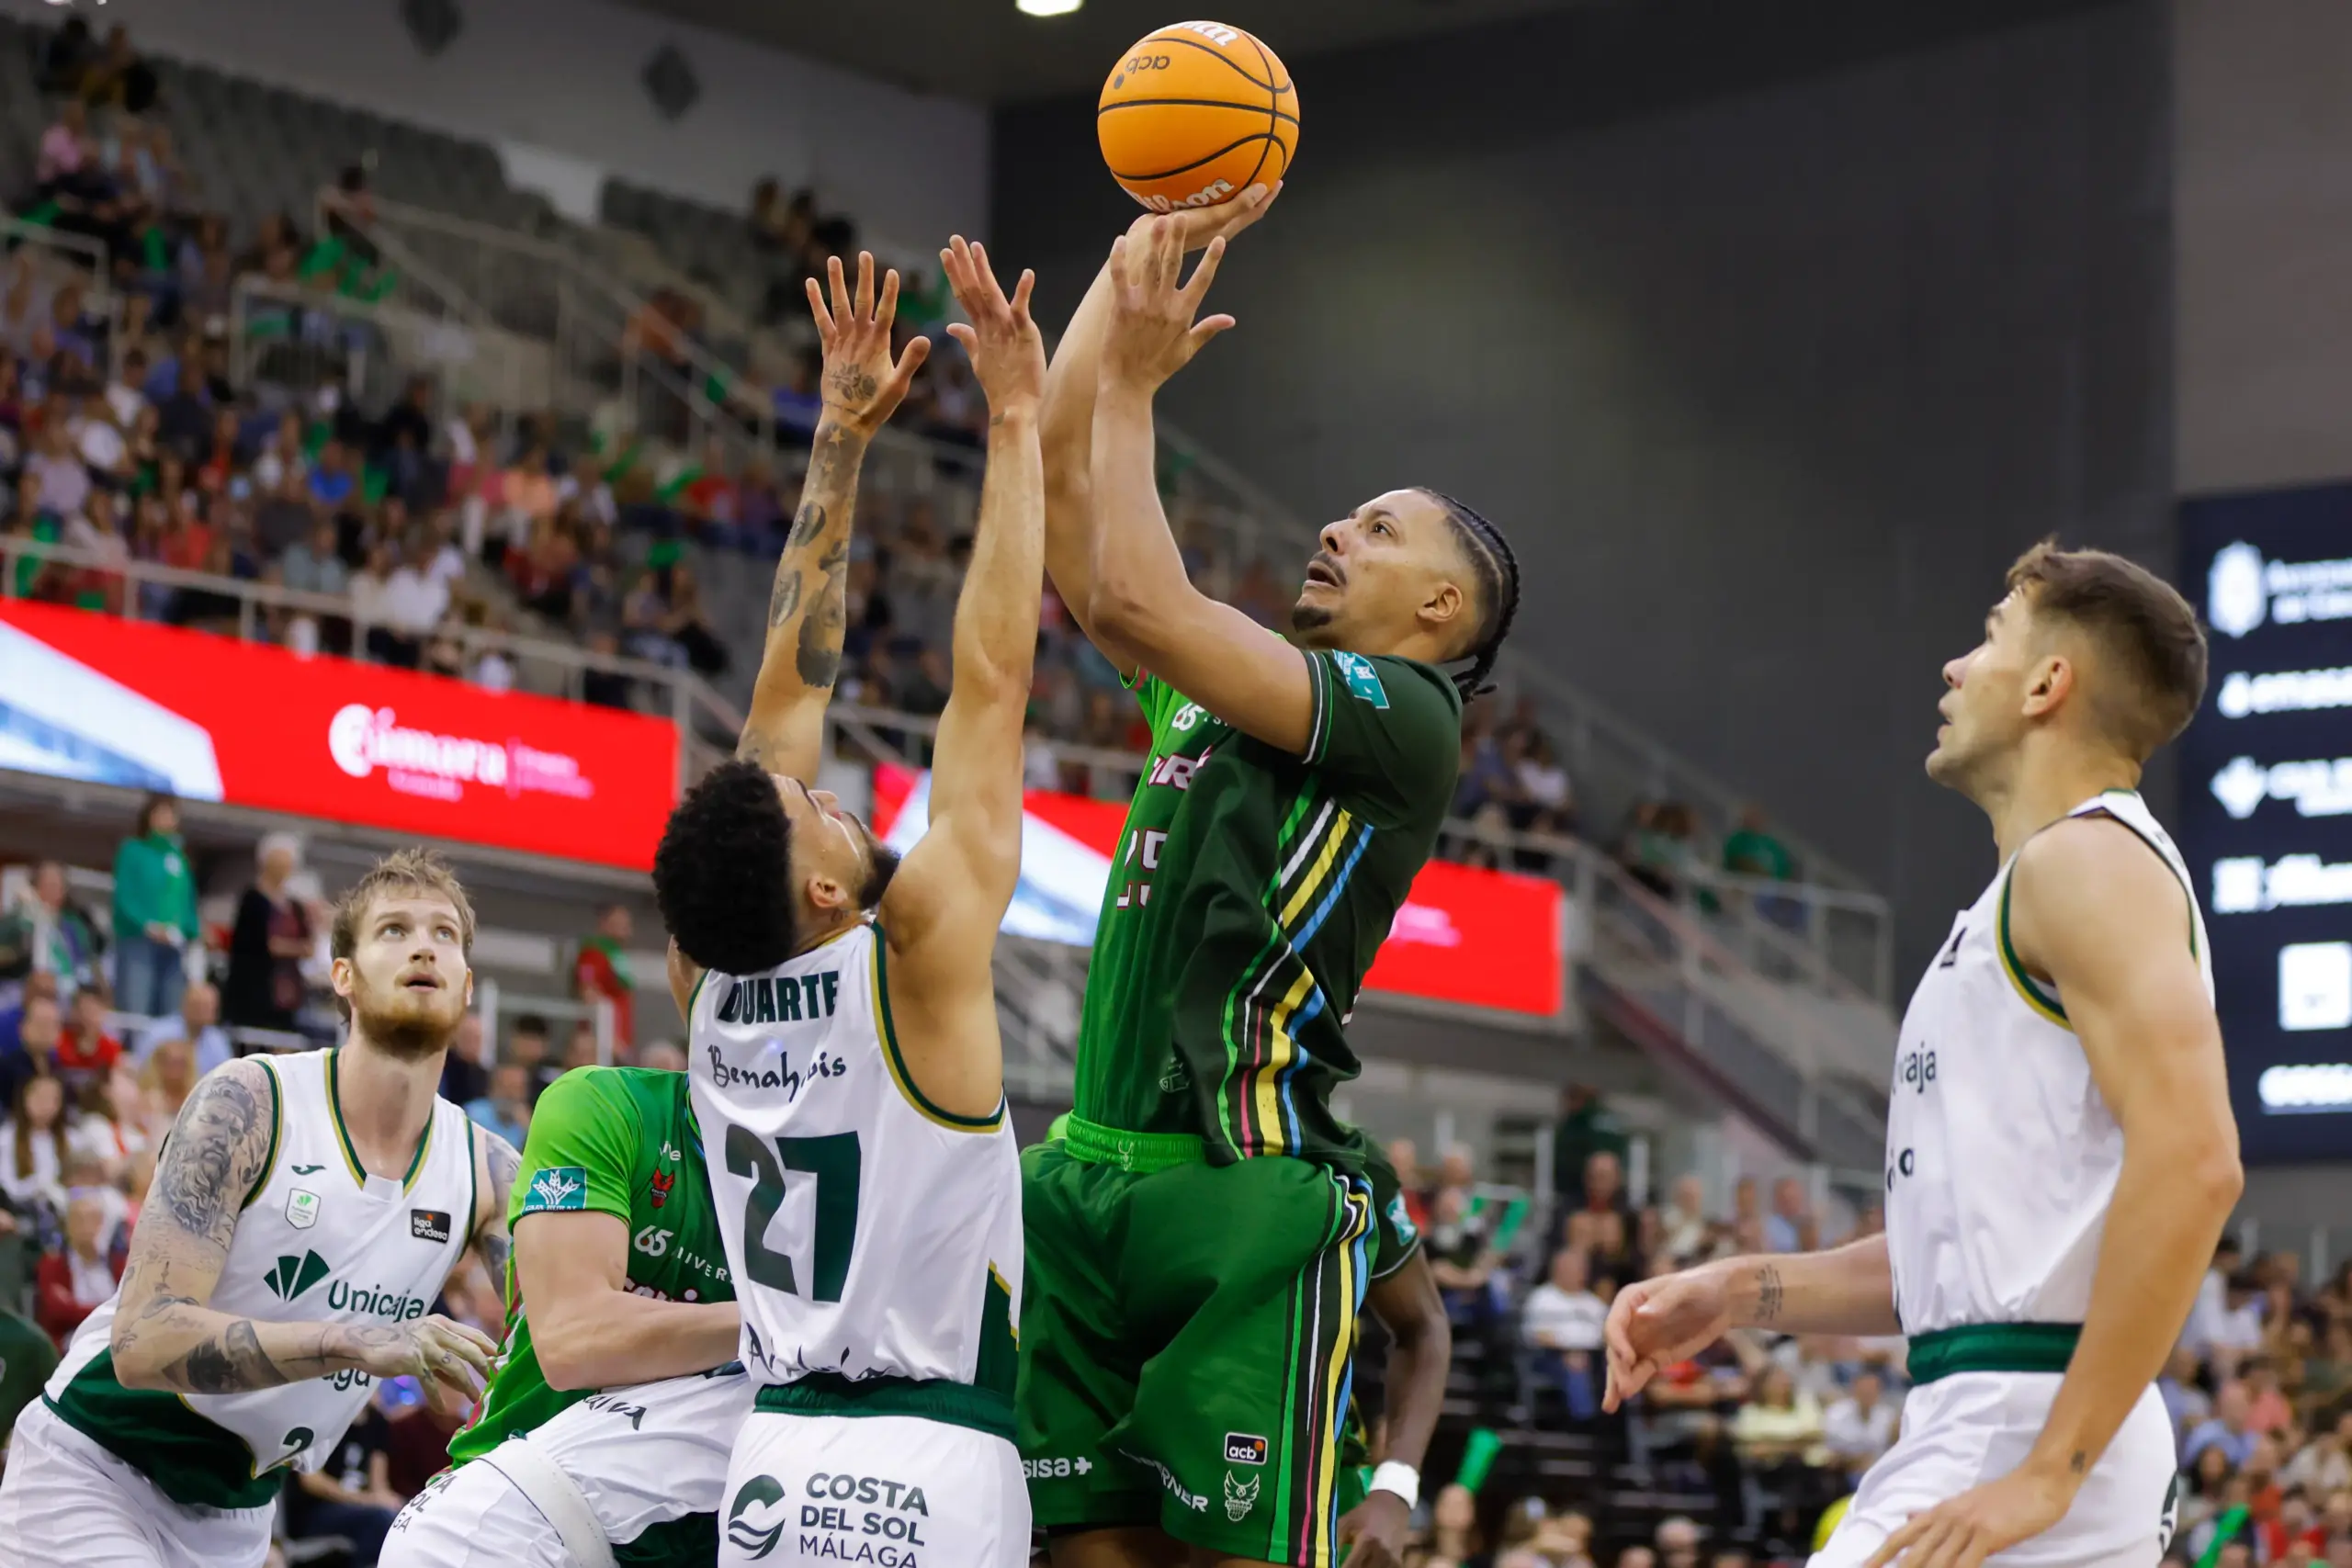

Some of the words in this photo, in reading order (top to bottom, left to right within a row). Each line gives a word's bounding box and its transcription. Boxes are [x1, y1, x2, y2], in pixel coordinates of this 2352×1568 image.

[1125, 55, 1170, 74] acb
[718, 970, 839, 1025] DUARTE
[413, 1216, 432, 1228] liga
[725, 1123, 862, 1303] 27
[634, 1224, 674, 1257] 65
[1228, 1445, 1257, 1461] acb
[806, 1472, 929, 1517] COSTA
[800, 1505, 854, 1531] DEL
[862, 1512, 925, 1547] SOL
[799, 1531, 918, 1568] MÁLAGA
